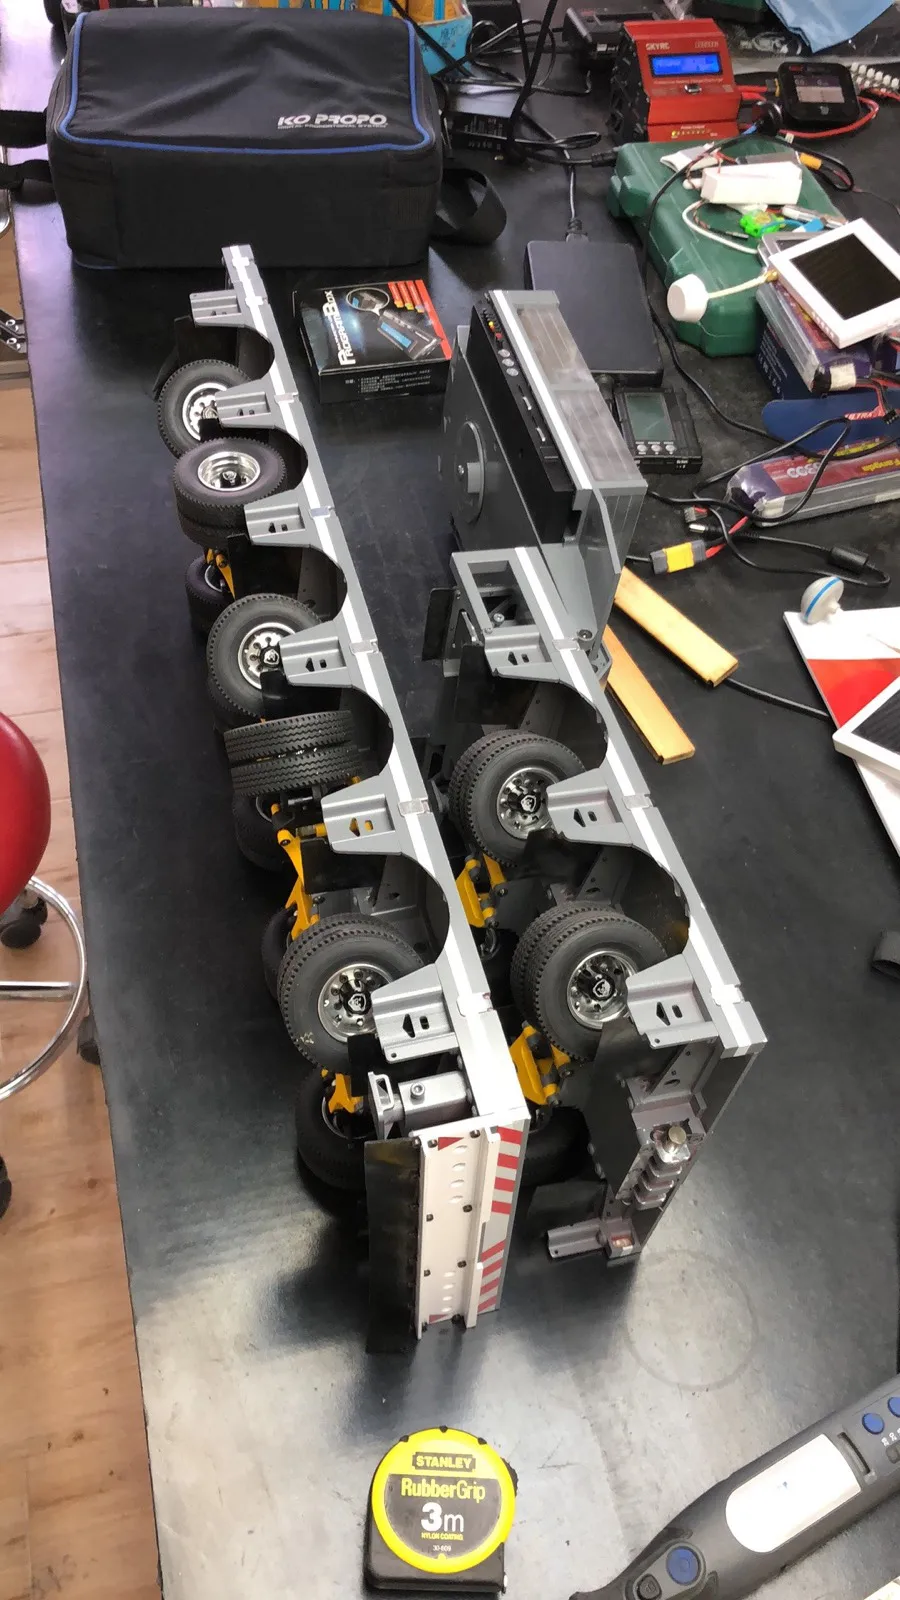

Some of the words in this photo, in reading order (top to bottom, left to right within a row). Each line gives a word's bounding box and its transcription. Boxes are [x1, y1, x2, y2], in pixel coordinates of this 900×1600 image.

[645, 42, 671, 51] SKYRC
[277, 115, 311, 126] KO
[314, 114, 387, 125] PROPO
[416, 1455, 473, 1469] STANLEY
[401, 1477, 486, 1504] RubberGrip
[421, 1532, 440, 1540] NYLON
[440, 1533, 464, 1541] COATING
